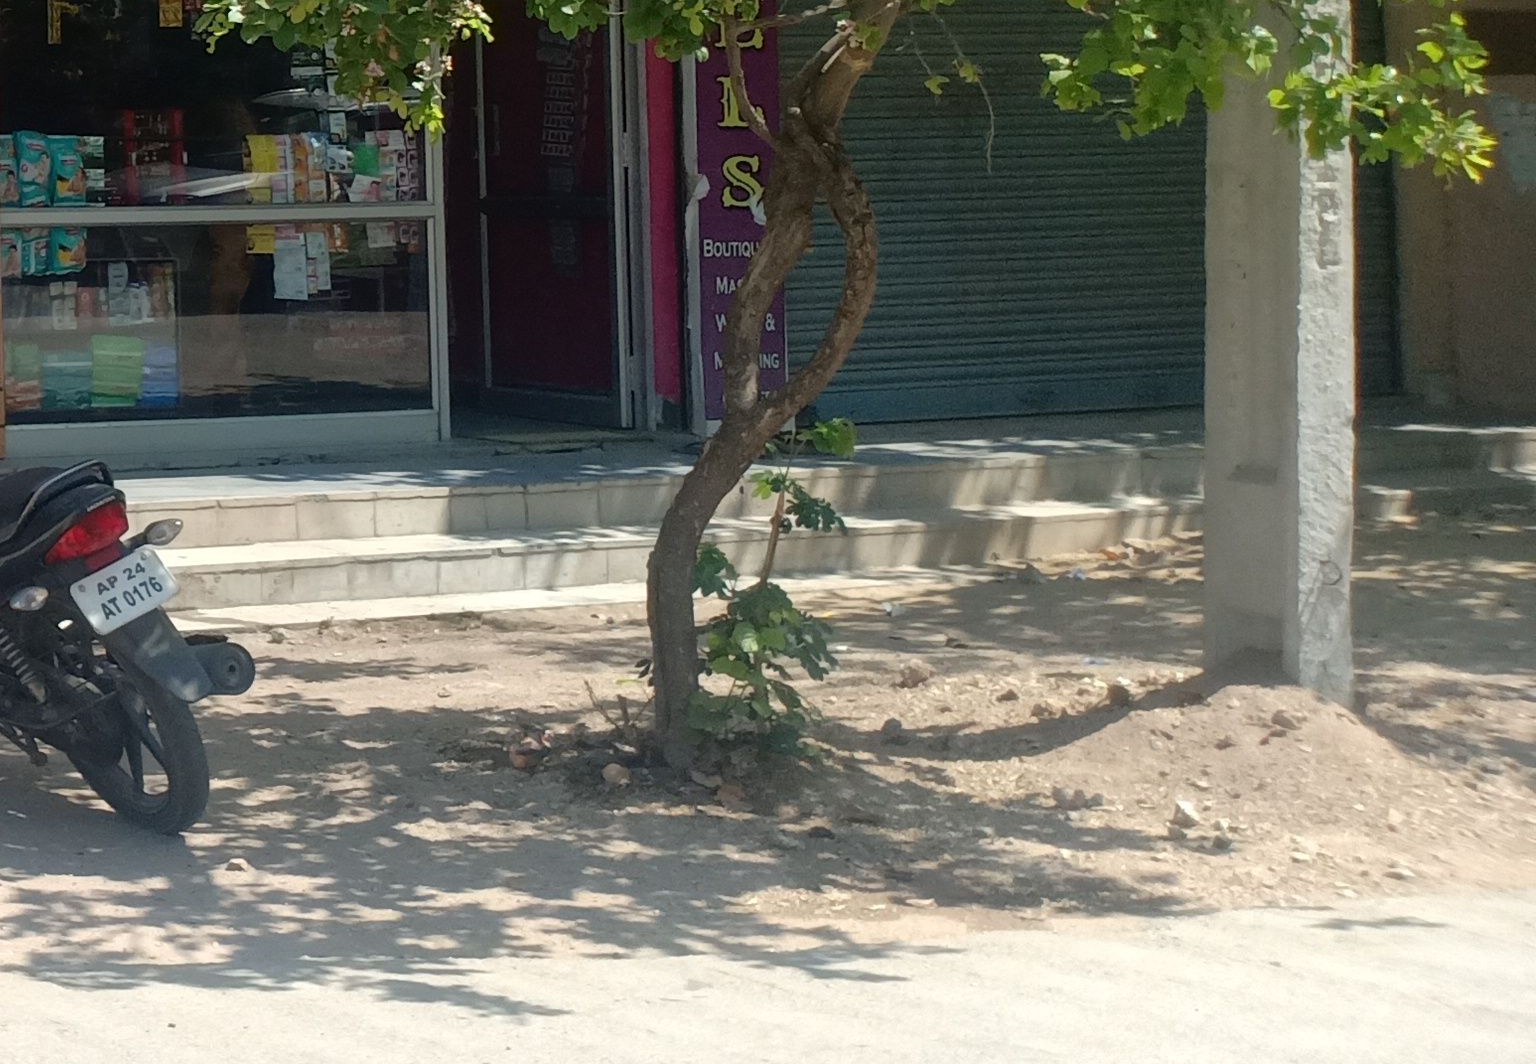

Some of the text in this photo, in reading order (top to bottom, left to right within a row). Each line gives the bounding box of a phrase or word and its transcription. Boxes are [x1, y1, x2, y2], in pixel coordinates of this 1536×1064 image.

[96, 562, 146, 596] AP 24
[100, 576, 163, 620] AT 0176
